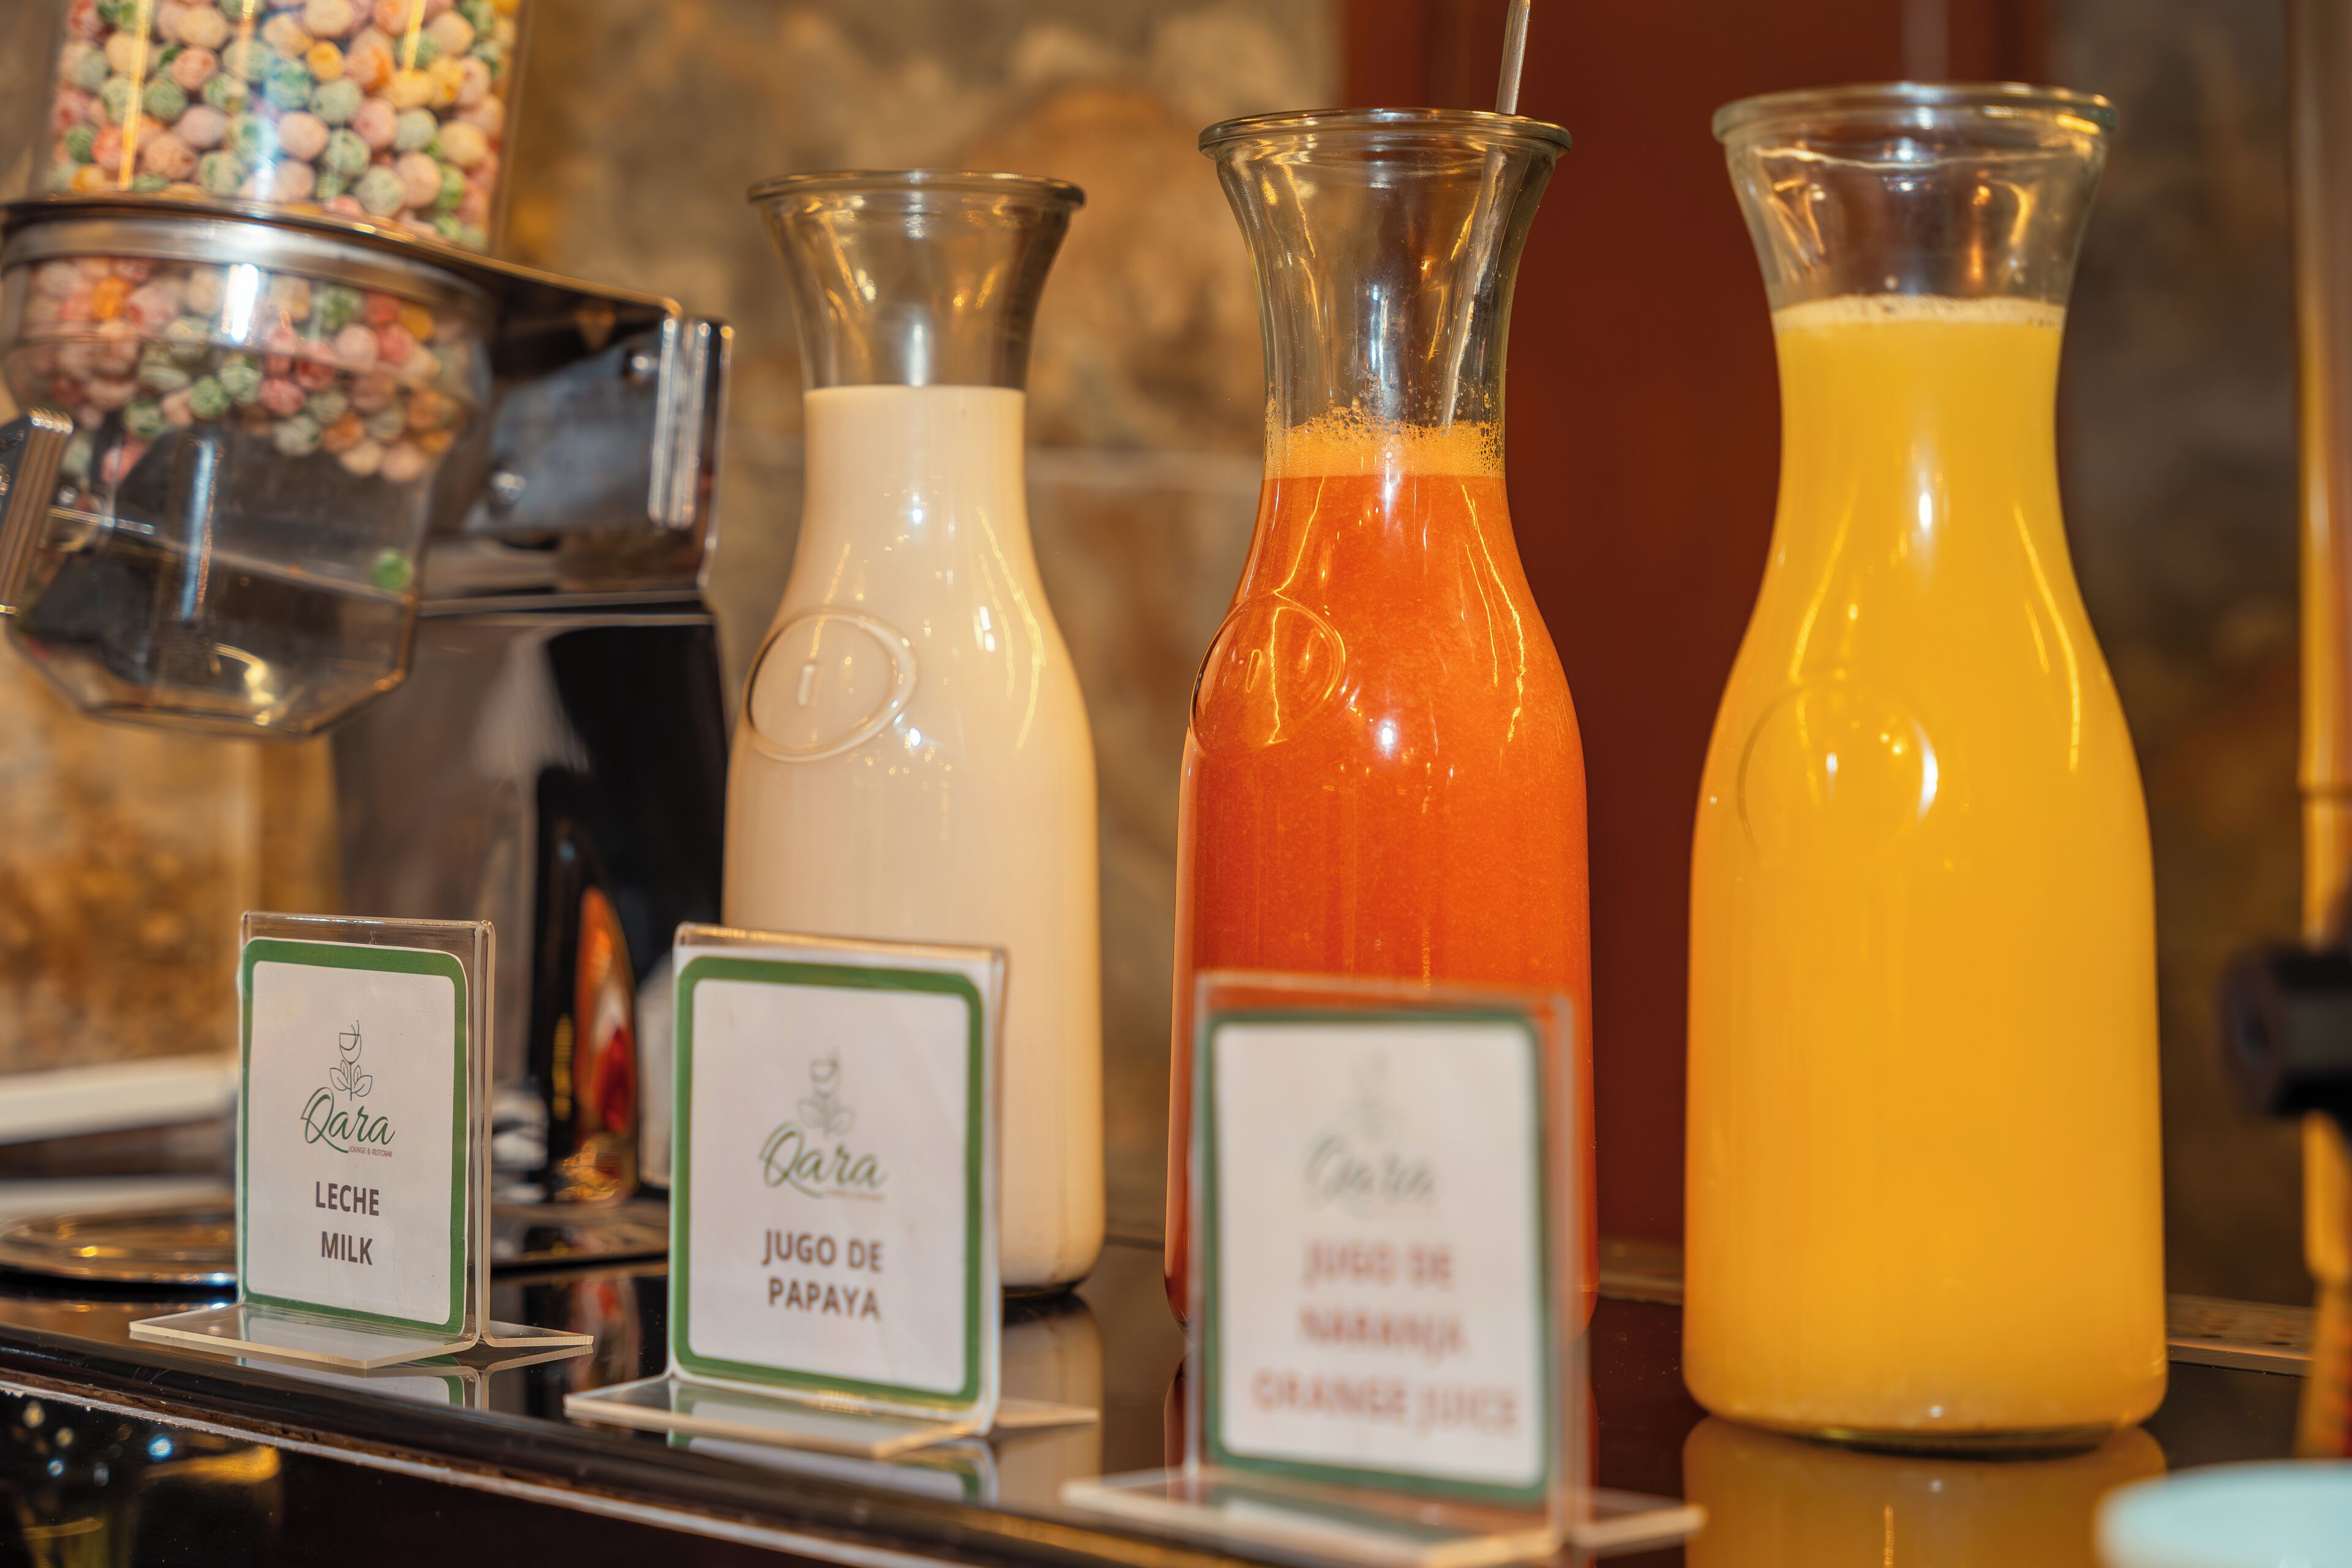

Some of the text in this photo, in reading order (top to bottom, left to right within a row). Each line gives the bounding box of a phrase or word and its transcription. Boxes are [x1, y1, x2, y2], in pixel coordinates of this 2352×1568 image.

[301, 1087, 396, 1153] Qara
[758, 1120, 889, 1198] Qara
[316, 1181, 379, 1216] LECHE
[322, 1231, 373, 1265] MILK
[761, 1228, 883, 1273] JUGO DE
[1305, 1240, 1397, 1289] JUGO
[769, 1276, 881, 1321] PAPAYA
[1253, 1370, 1519, 1436] ORANGE JUICE
